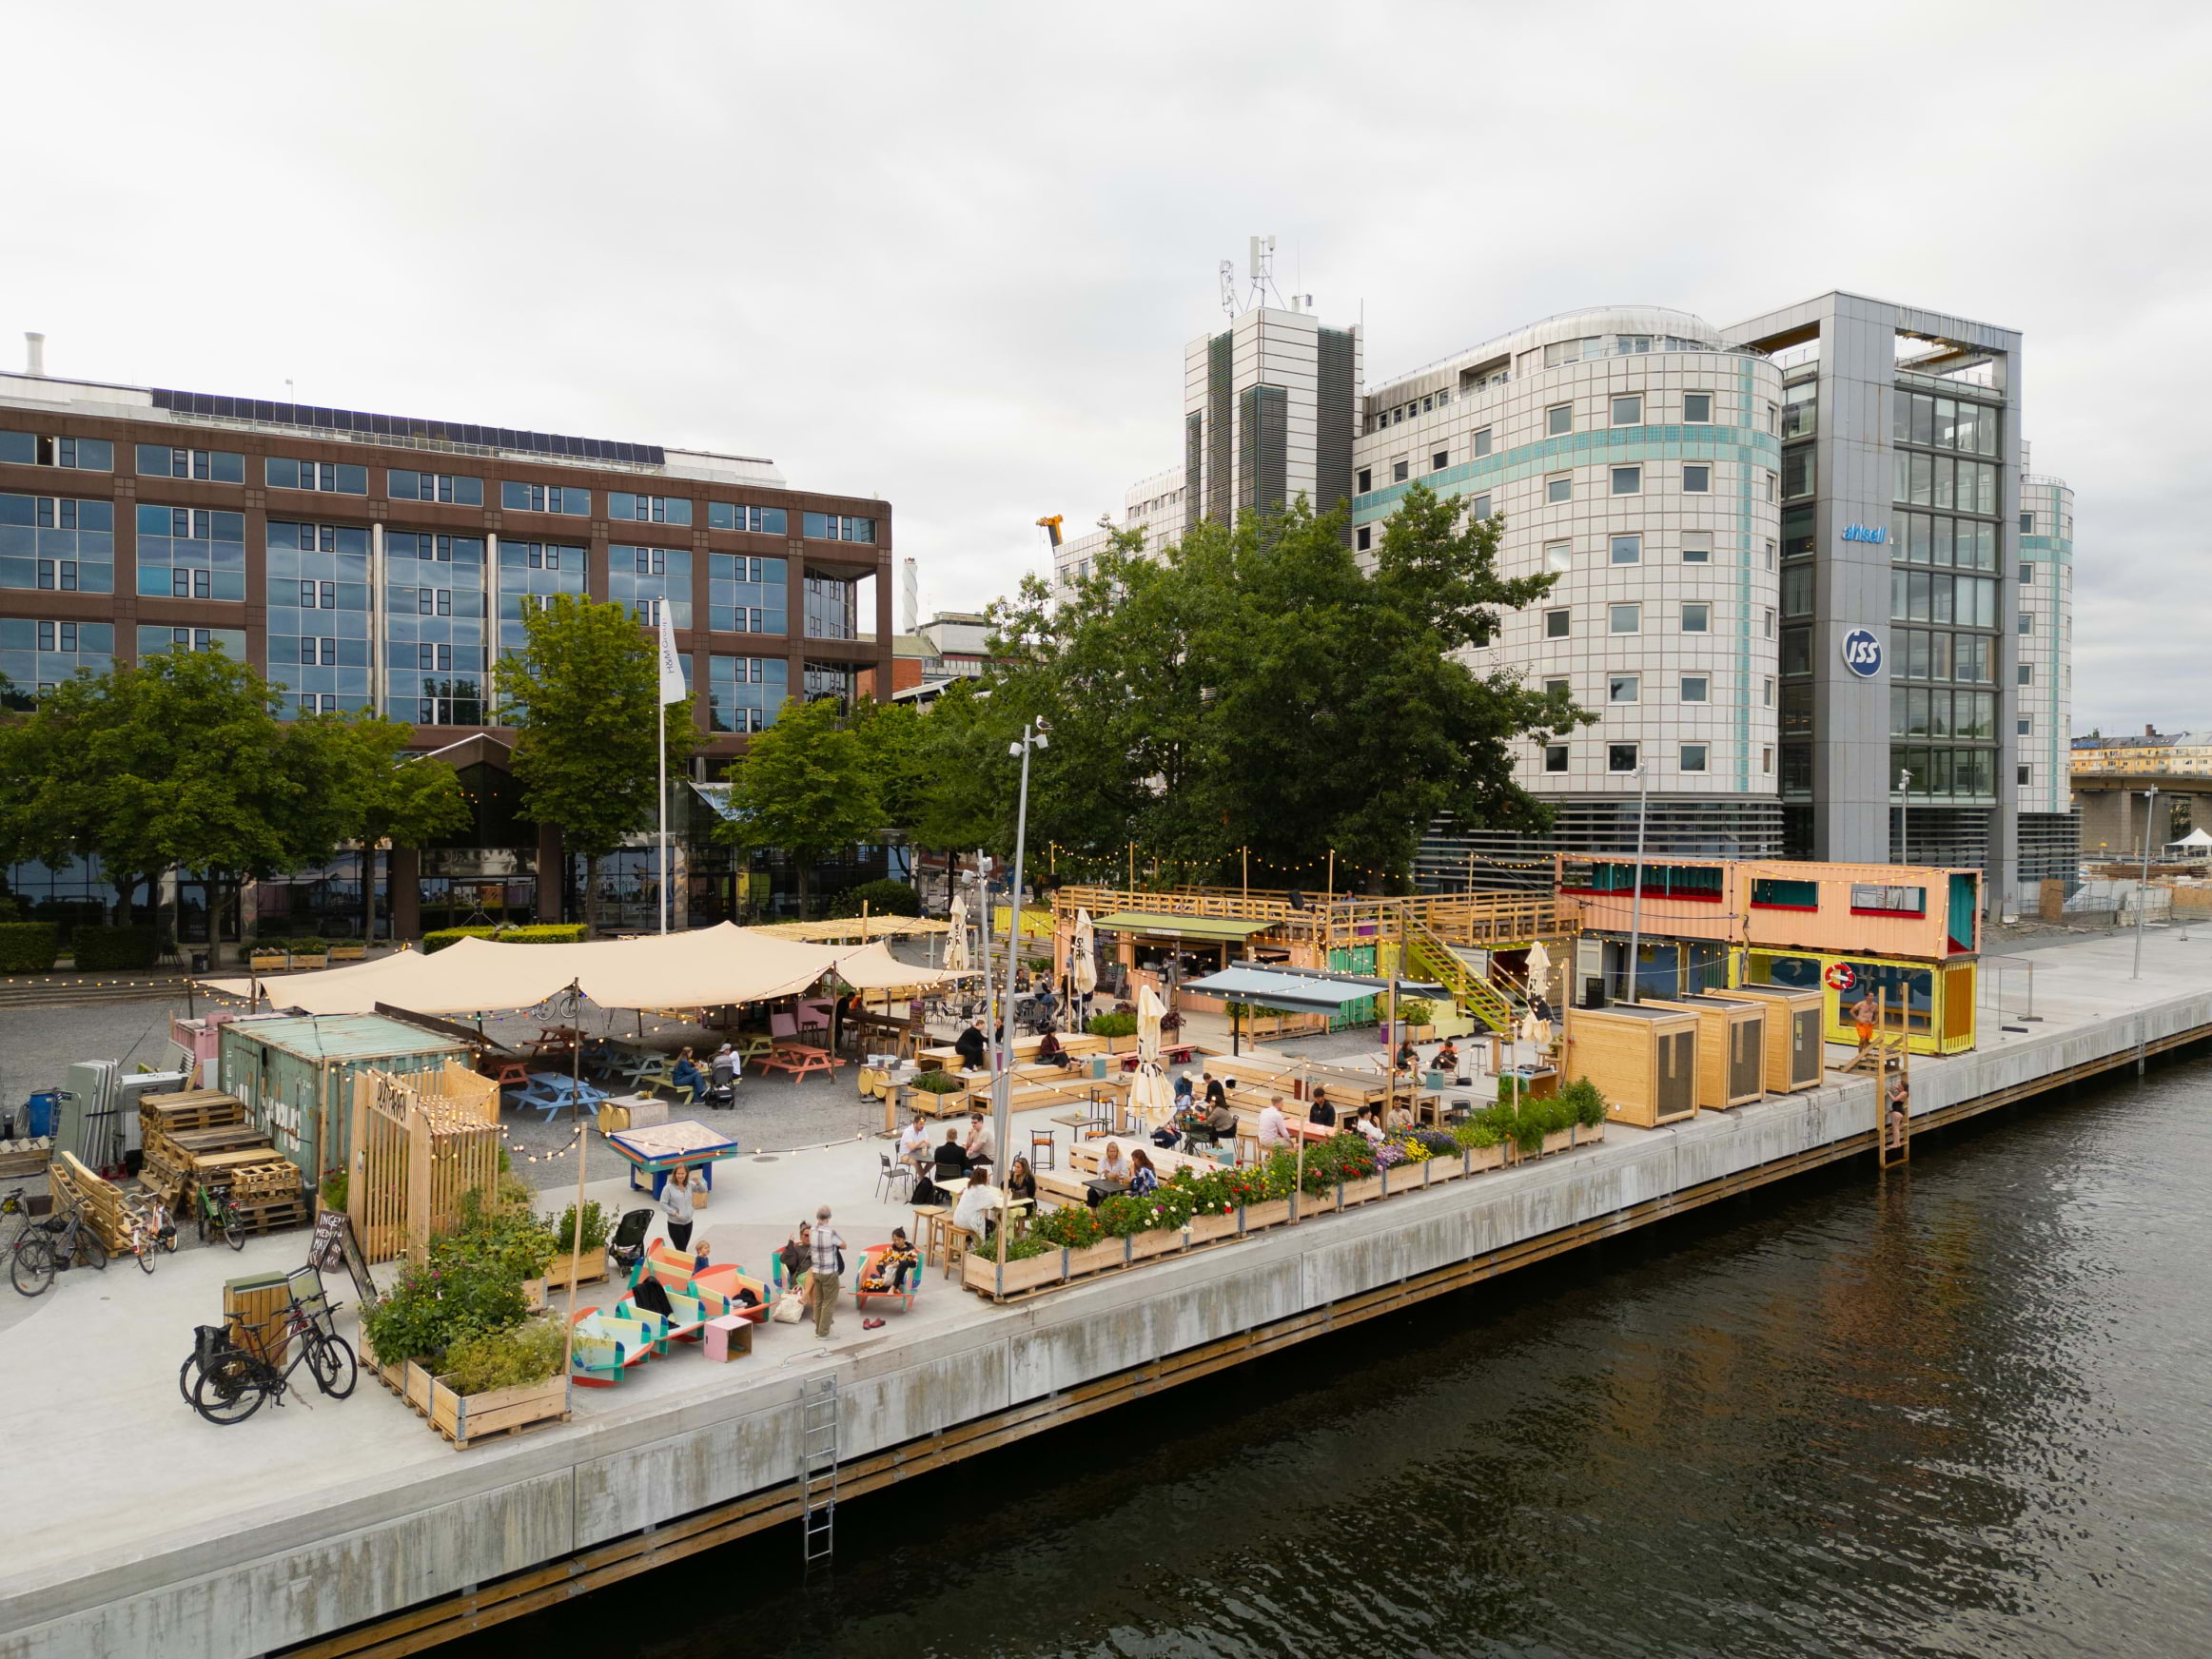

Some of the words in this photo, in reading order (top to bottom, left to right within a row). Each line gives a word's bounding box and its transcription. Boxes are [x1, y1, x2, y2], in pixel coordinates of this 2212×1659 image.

[1842, 523, 1886, 543] ahlsell
[1848, 632, 1879, 663] ISS
[662, 651, 674, 673] H&M
